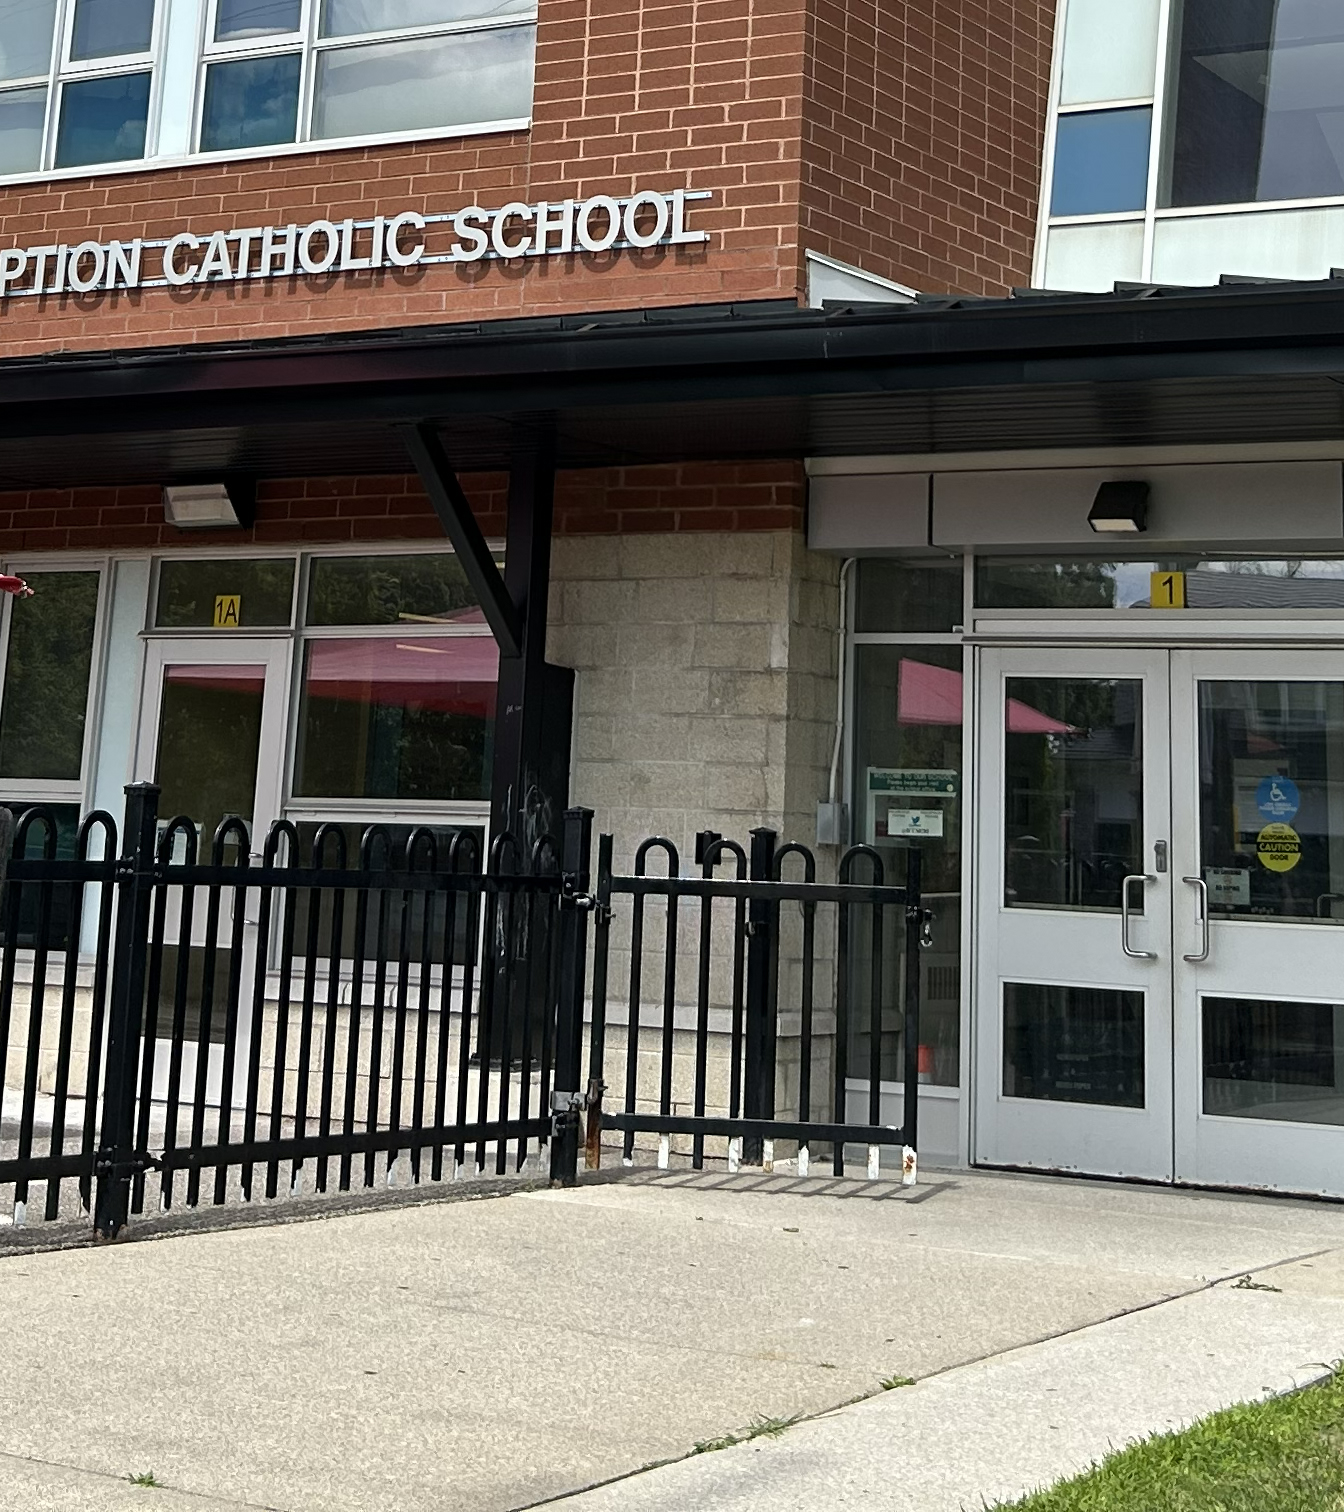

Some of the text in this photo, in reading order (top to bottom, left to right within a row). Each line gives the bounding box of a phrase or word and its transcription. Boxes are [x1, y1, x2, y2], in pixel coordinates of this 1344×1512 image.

[162, 211, 426, 286] CATHOLIC
[451, 188, 705, 262] SCHOOL
[1162, 574, 1173, 605] 1
[216, 598, 238, 624] 1A
[1259, 842, 1299, 852] CAUTION
